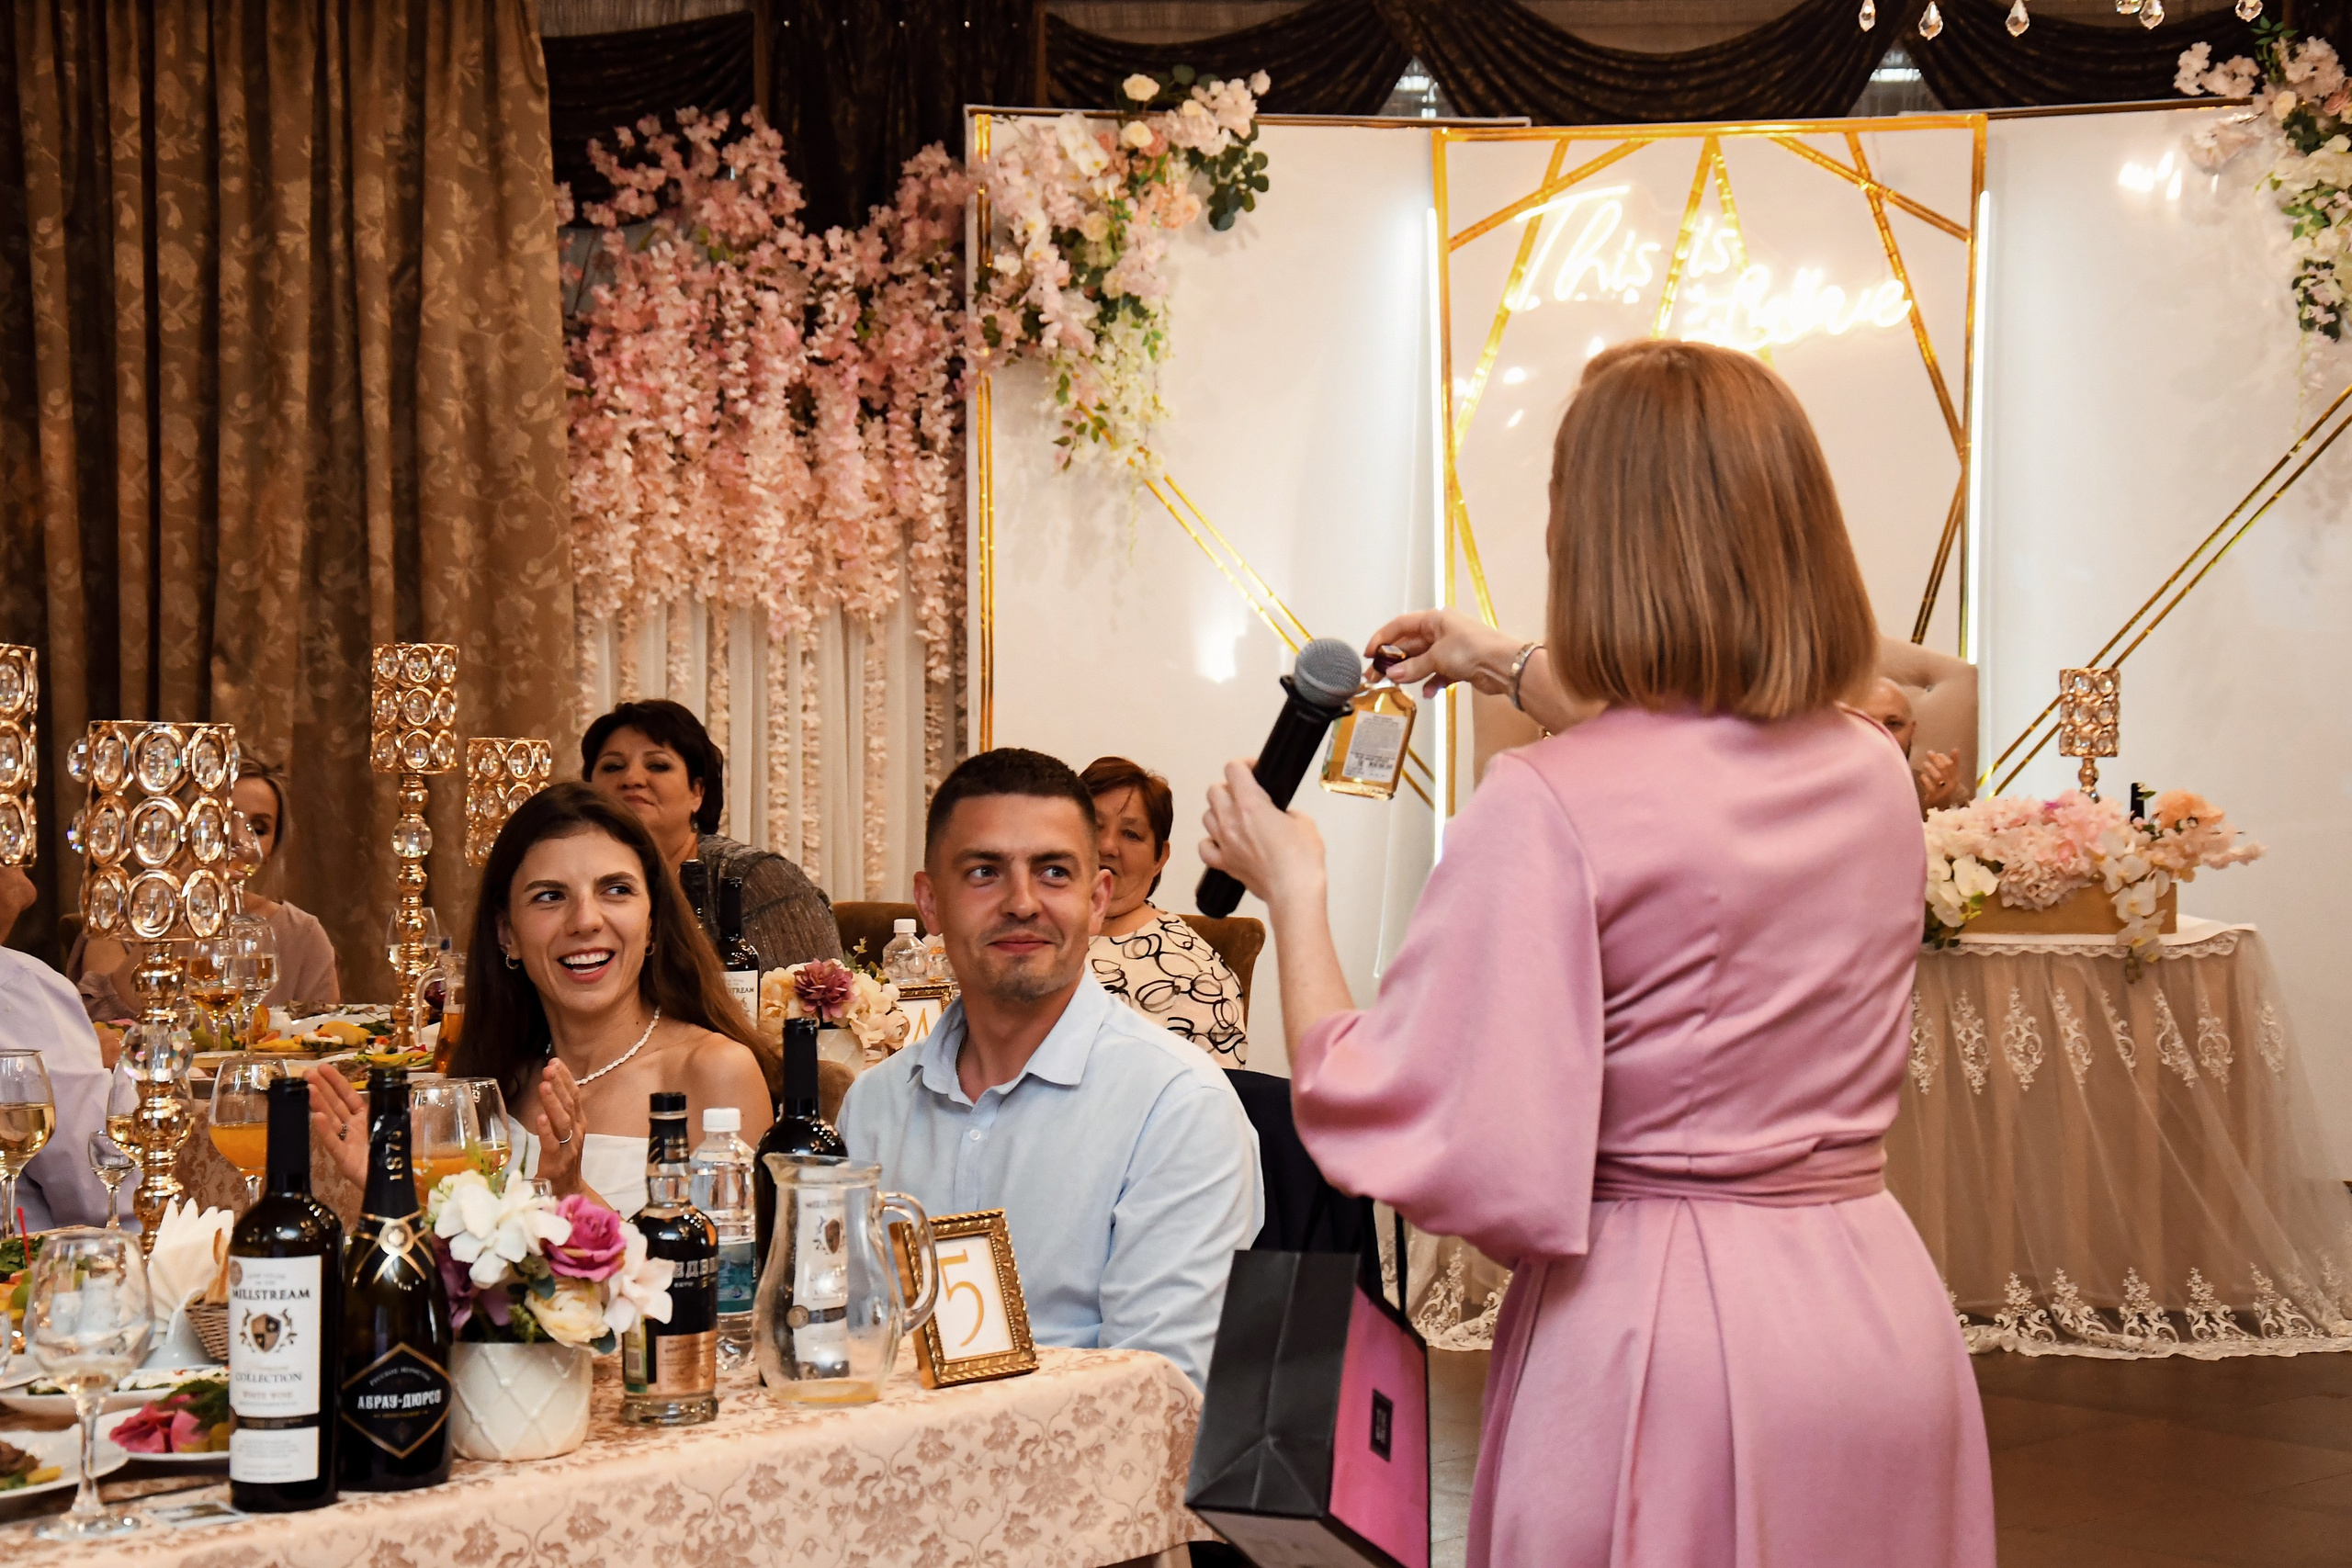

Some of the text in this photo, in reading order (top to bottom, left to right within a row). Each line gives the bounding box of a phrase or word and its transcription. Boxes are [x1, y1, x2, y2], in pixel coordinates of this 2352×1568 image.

[1512, 185, 1737, 310] This is
[232, 1288, 311, 1301] MILLSTREAM
[938, 1248, 984, 1348] 5
[234, 1371, 304, 1383] COLLECTION
[356, 1389, 442, 1410] АБРАУ-ДЮРСО
